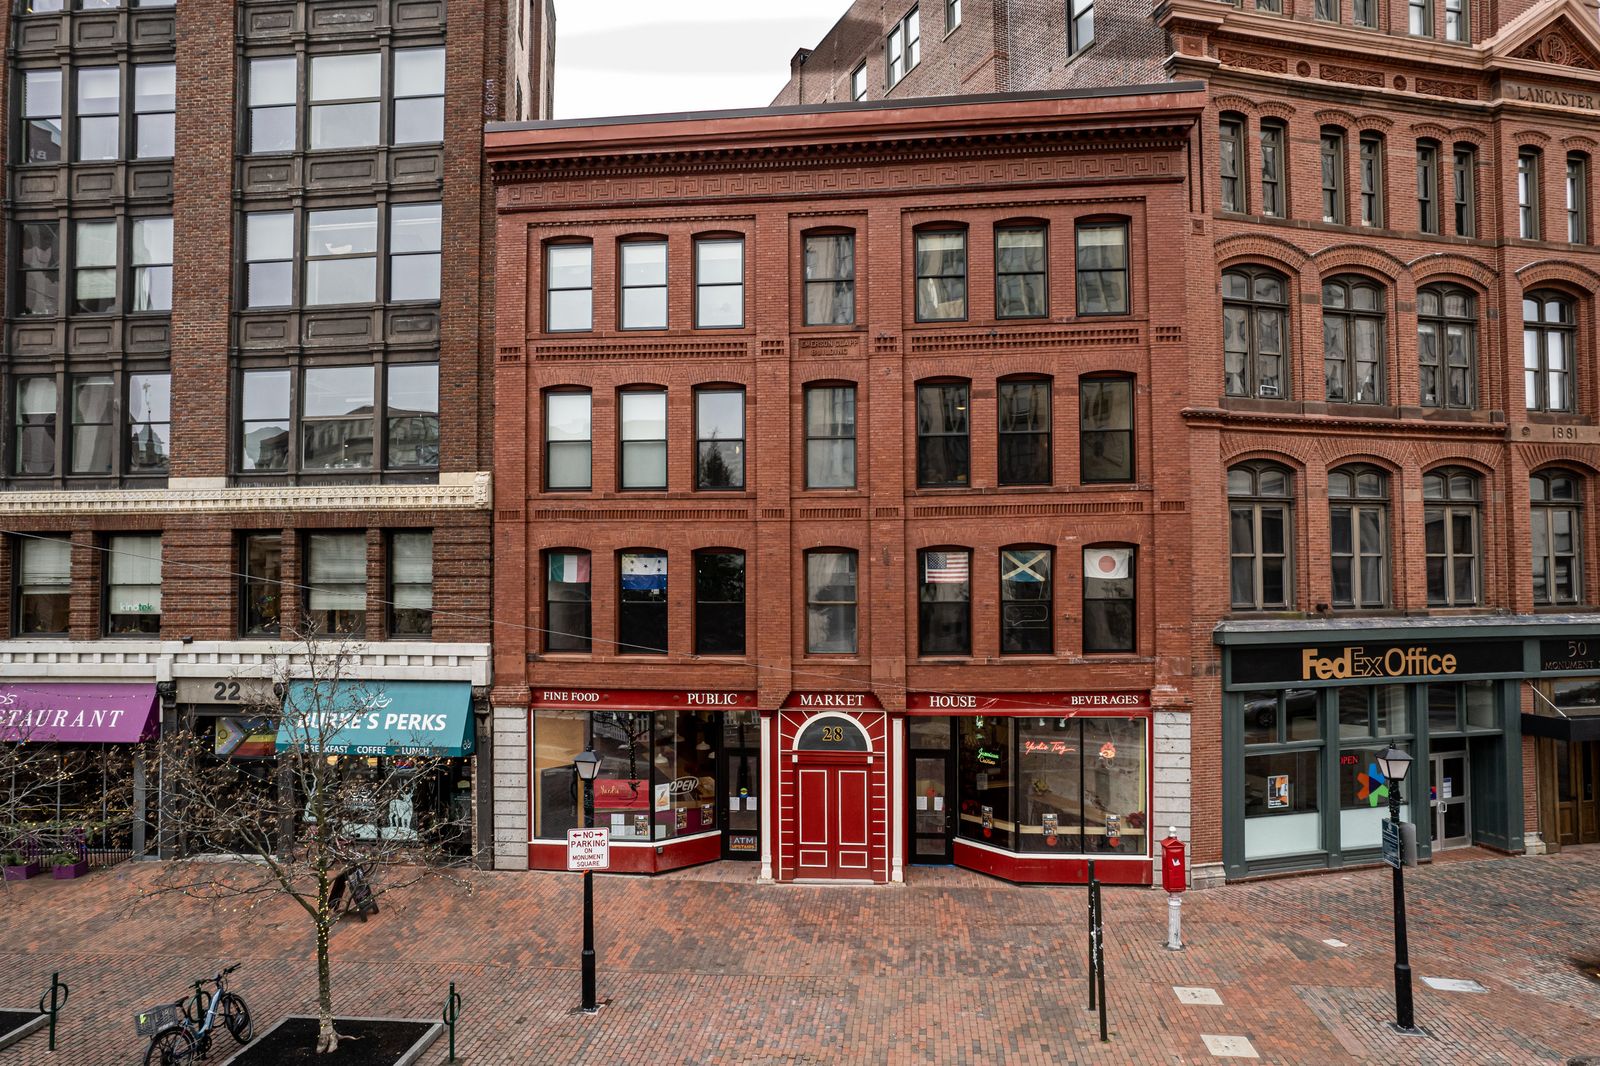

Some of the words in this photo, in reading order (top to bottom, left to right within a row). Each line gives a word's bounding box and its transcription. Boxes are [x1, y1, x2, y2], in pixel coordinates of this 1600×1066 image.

[1517, 86, 1594, 110] LANCASTER
[834, 339, 859, 347] CLAPP
[1552, 426, 1578, 440] 1881
[1568, 640, 1587, 658] 50
[1302, 647, 1383, 680] FedEx
[1384, 647, 1457, 676] Office
[1544, 660, 1594, 670] MONUMENT
[214, 681, 241, 701] 22
[543, 691, 569, 702] FINE
[571, 692, 600, 702] FOOD
[687, 693, 738, 705] PUBLIC
[800, 694, 865, 707] MARKET
[929, 696, 977, 708] HOUSE
[1071, 695, 1139, 705] BEVERAGES
[384, 713, 448, 731] PERKS
[822, 726, 843, 741] 28
[304, 744, 349, 754] BREKFAST
[356, 746, 387, 754] COFFEE
[401, 747, 430, 755] LUNCH
[670, 780, 696, 792] OPEN
[583, 831, 594, 839] NO
[570, 840, 606, 848] PARKING
